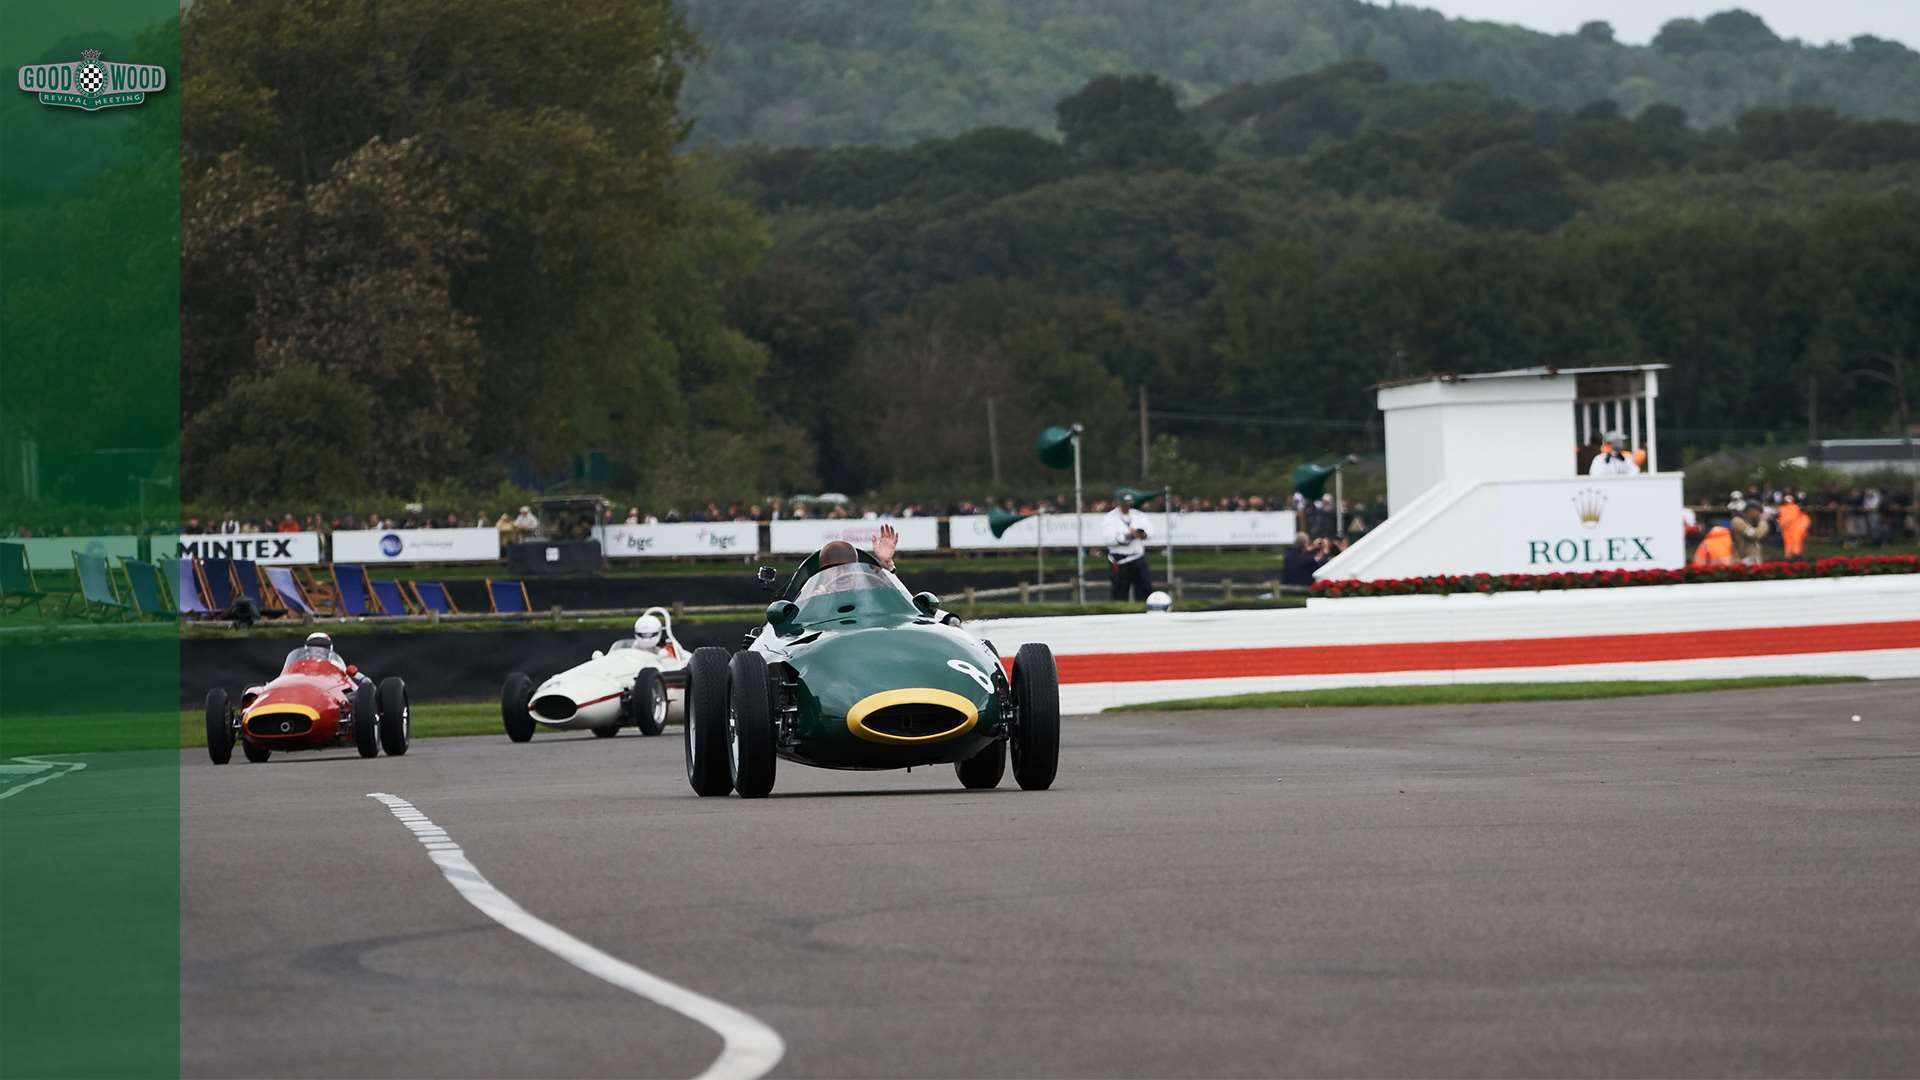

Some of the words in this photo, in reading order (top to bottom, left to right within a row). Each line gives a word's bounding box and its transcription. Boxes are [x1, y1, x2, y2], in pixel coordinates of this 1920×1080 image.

[177, 539, 292, 559] MINTEX
[1529, 536, 1655, 564] ROLEX
[947, 659, 995, 694] 8
